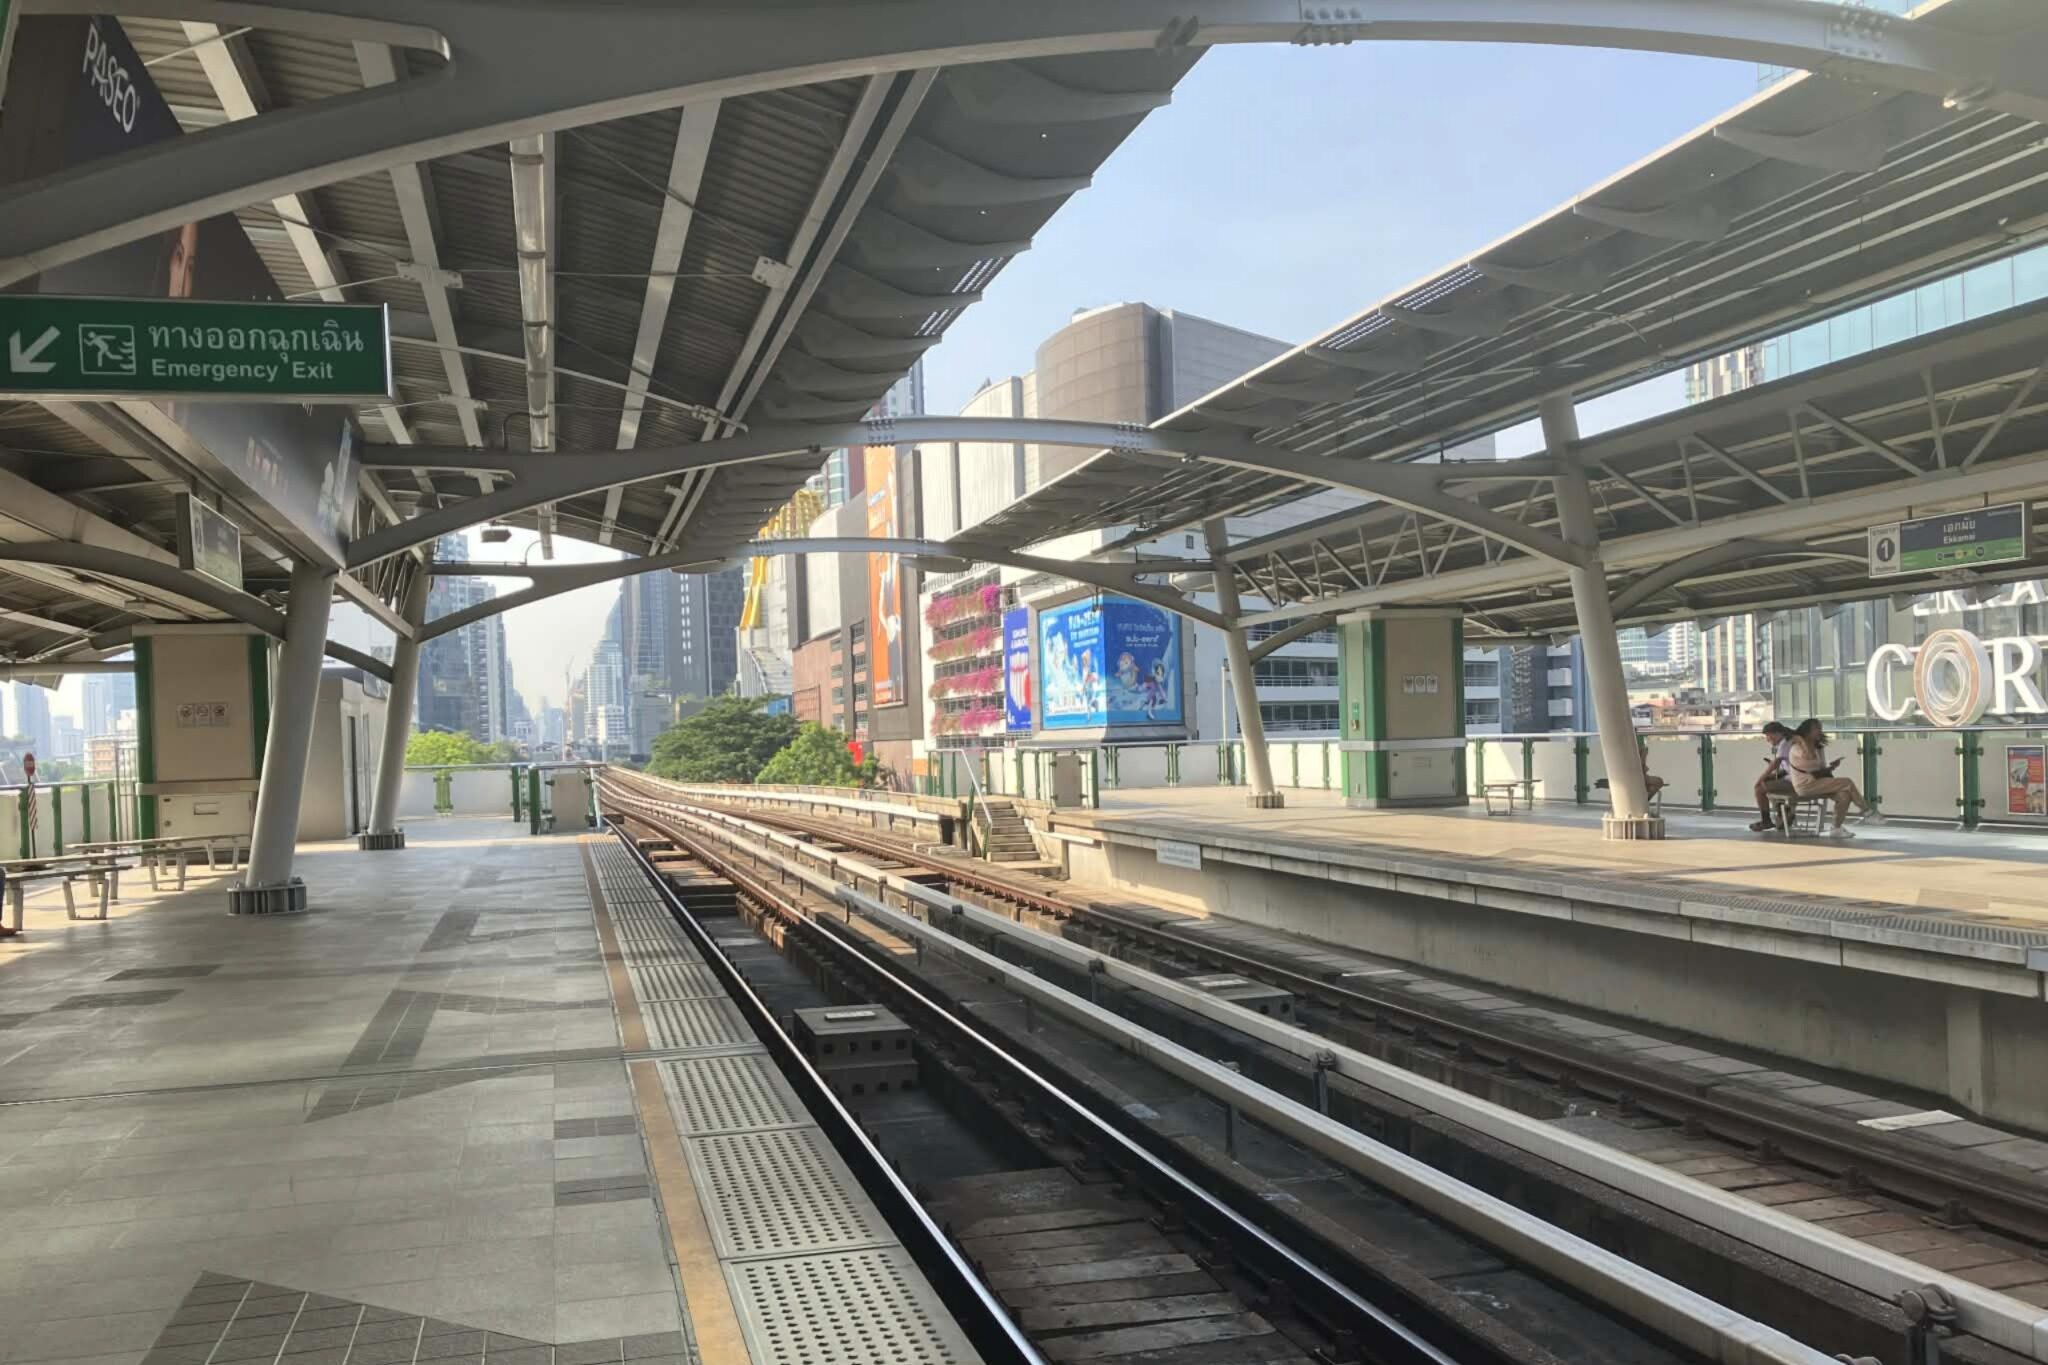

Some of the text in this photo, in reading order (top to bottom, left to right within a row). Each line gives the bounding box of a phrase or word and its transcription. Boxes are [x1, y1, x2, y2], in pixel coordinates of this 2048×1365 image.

[83, 22, 136, 133] PASEO
[148, 319, 364, 364] ทางออกฉุกเฉิน
[151, 358, 334, 382] Emergency Exit
[1943, 533, 1977, 545] Ekkamai
